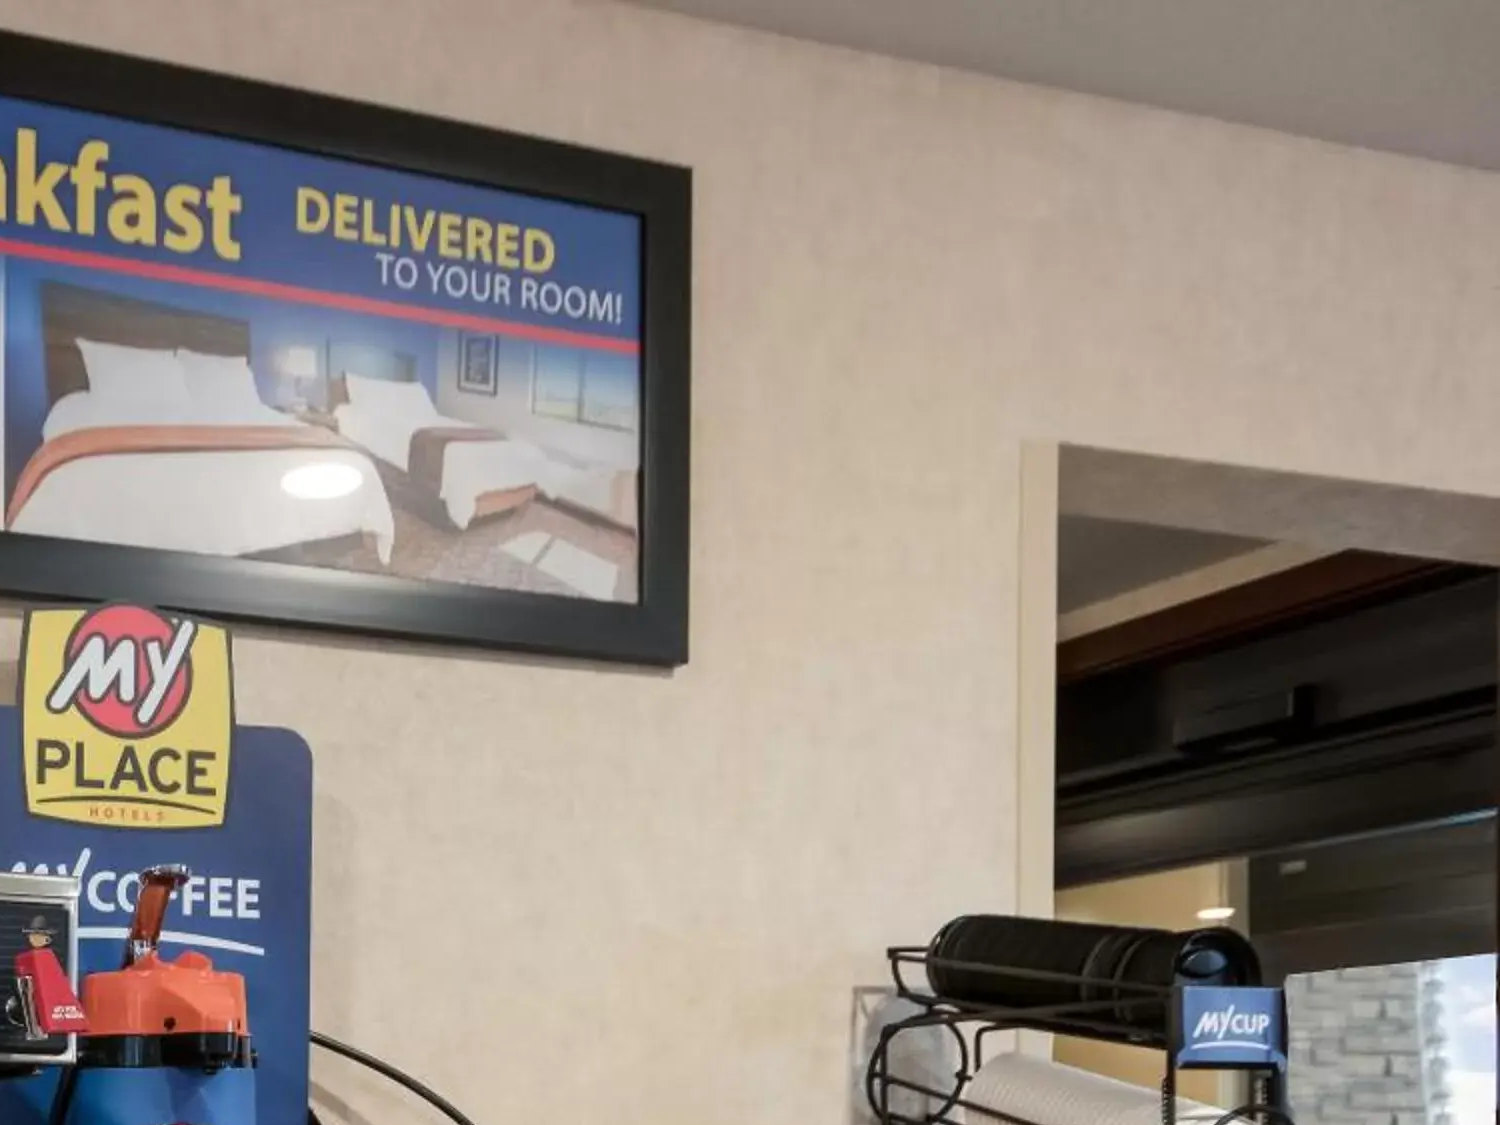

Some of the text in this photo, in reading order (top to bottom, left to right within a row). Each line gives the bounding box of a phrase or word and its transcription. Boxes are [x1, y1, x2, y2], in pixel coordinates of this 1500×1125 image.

[296, 187, 556, 273] DELIVERED
[375, 253, 623, 326] TO YOUR ROOM!
[36, 739, 217, 797] PLACE
[89, 806, 166, 822] HOTELS
